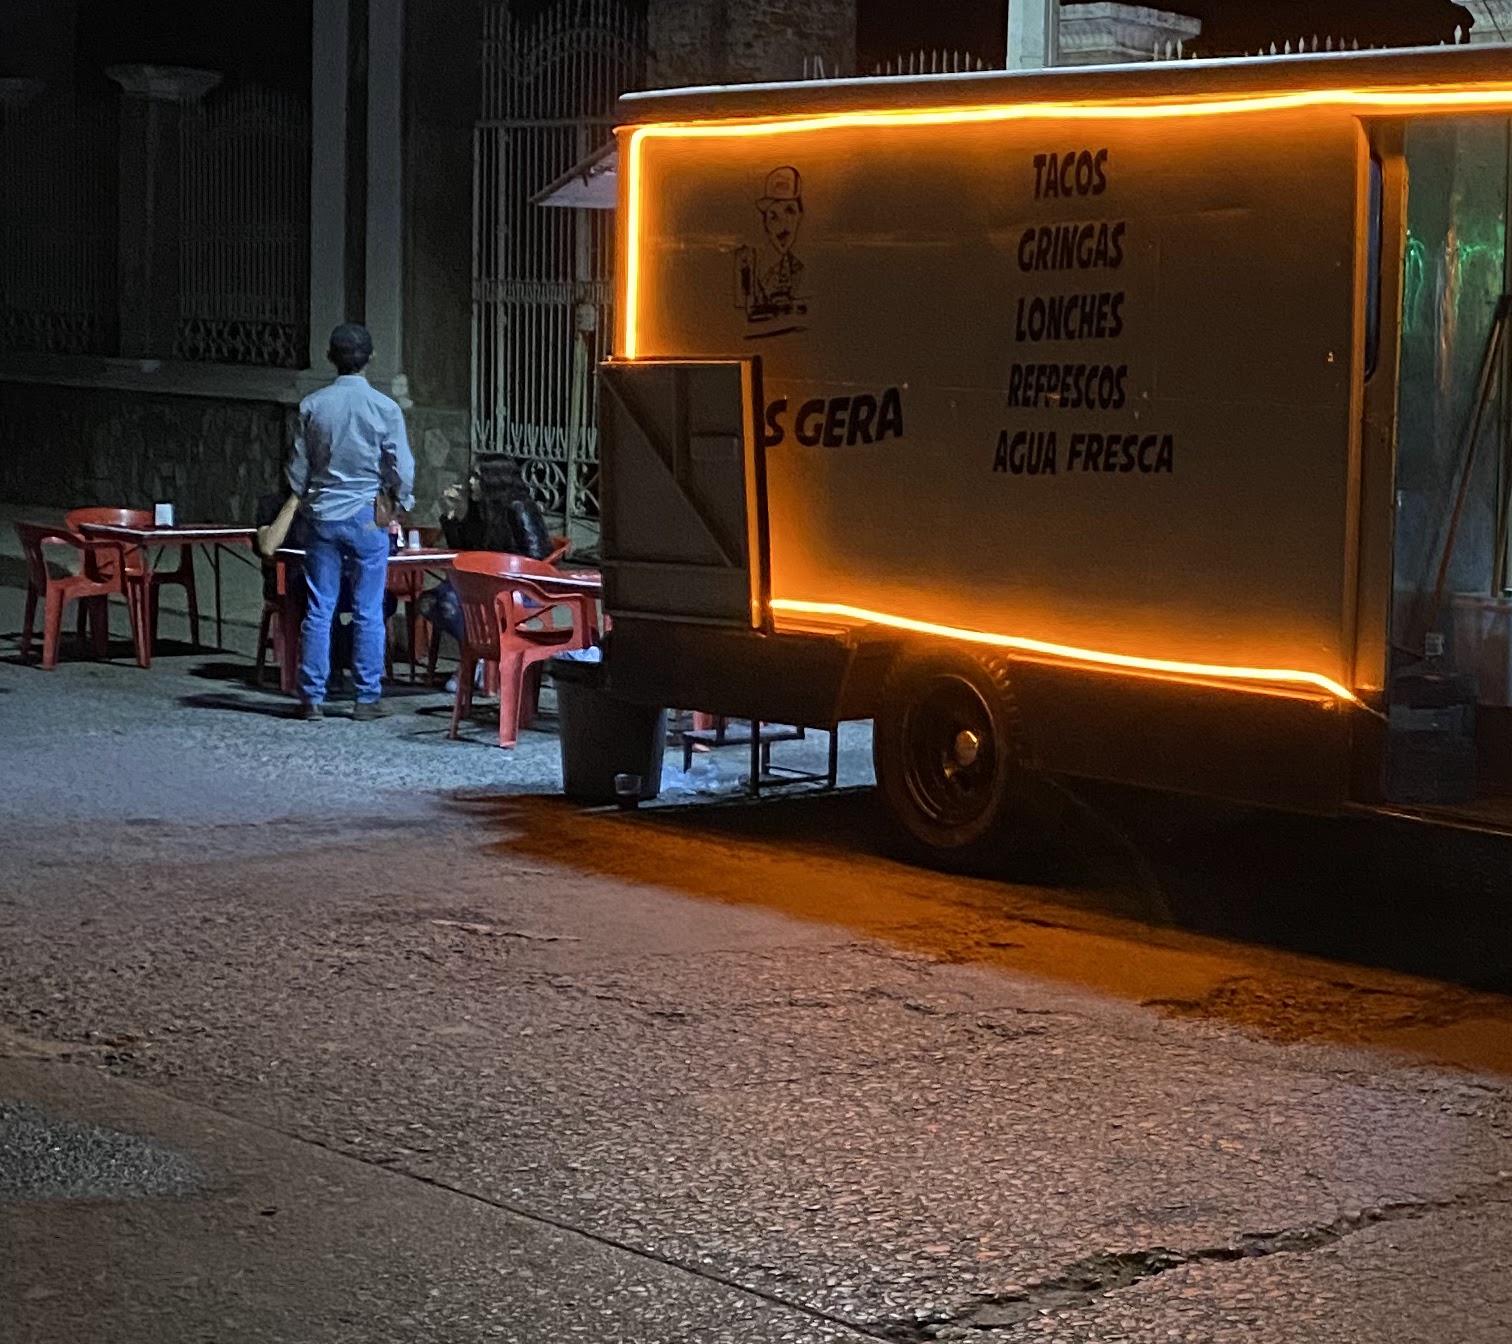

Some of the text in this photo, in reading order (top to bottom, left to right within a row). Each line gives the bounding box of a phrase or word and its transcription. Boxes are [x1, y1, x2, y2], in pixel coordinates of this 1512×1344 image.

[1033, 148, 1108, 199] TACOS
[1017, 221, 1126, 272] GRINGAS
[1015, 291, 1125, 342] LONCHES
[795, 387, 903, 447] GERA
[993, 430, 1174, 475] AGUA FRESCA
